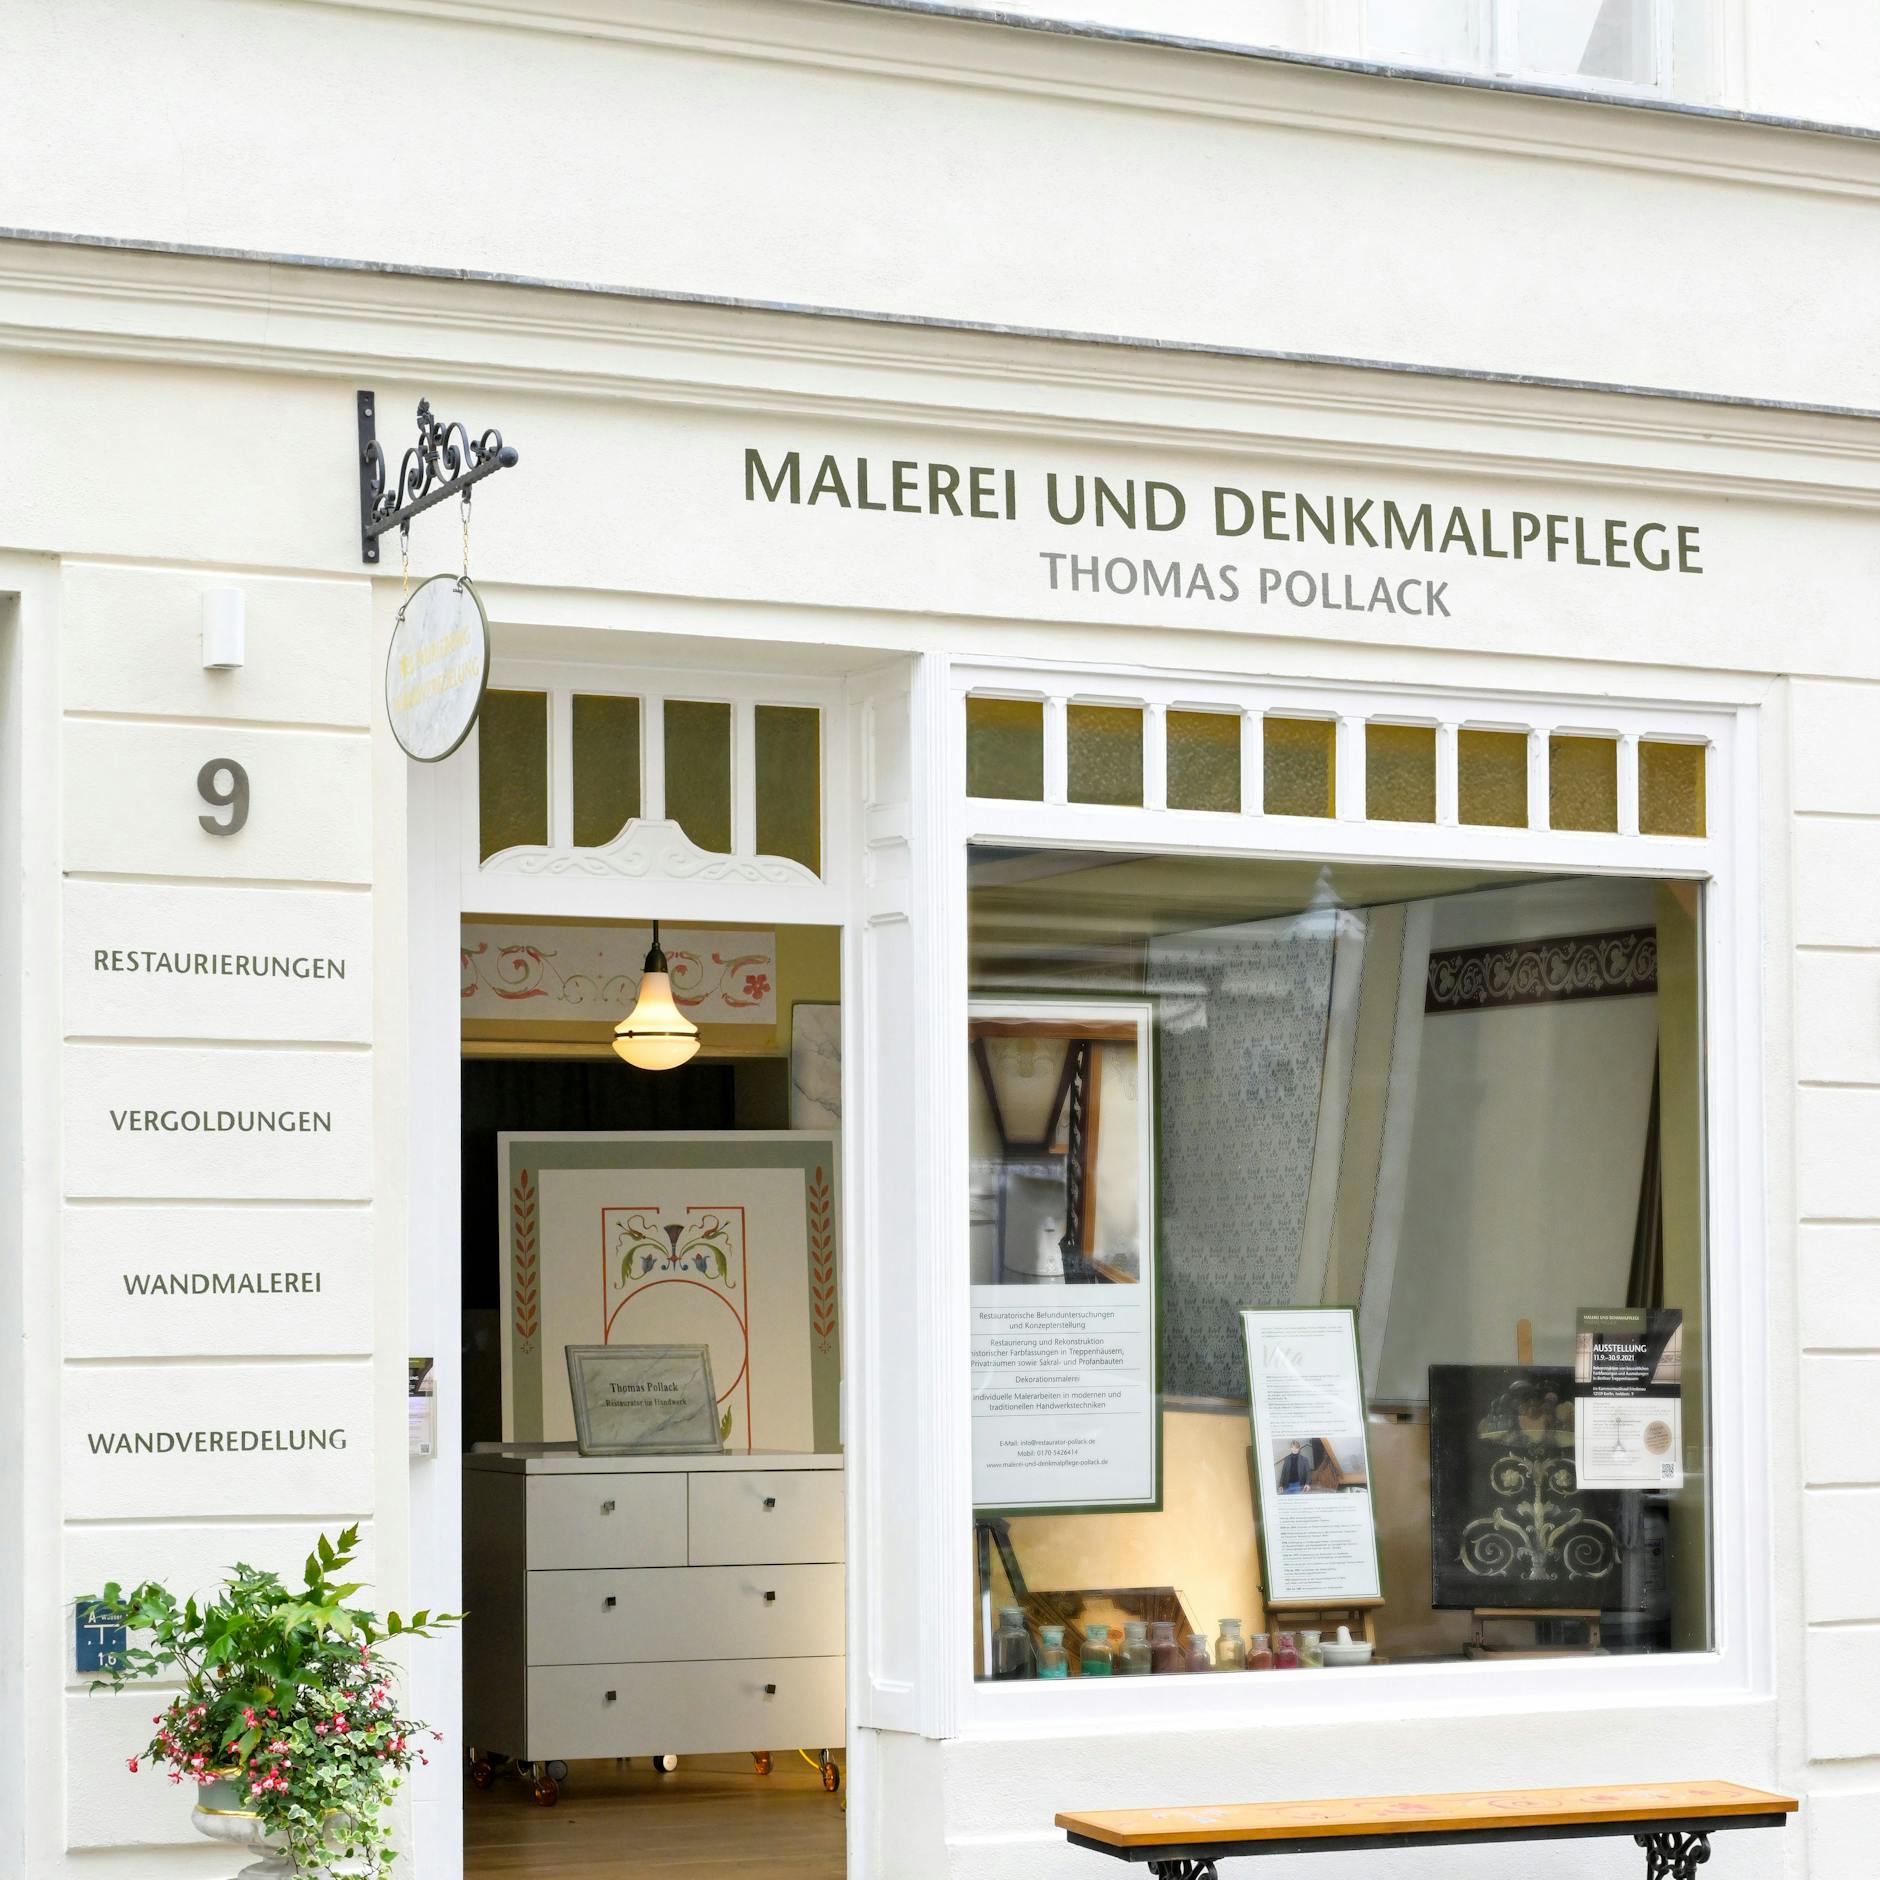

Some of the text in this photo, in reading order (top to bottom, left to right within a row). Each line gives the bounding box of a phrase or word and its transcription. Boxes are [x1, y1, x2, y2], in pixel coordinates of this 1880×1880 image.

[745, 449, 1703, 573] MALEREI UND DENKMALPFLEGE
[1040, 553, 1450, 616] THOMAS POLLACK
[198, 759, 249, 836] 9
[95, 951, 344, 978] RESTAURIERUNGEN
[110, 1111, 330, 1131] VERGOLDUNGEN
[124, 1273, 321, 1294] WANDMALEREI
[990, 1339, 1037, 1348] Restaurierung
[1055, 1337, 1104, 1345] Rekonstruktion
[1593, 1344, 1647, 1353] AUSSTELLUNG
[1010, 1349, 1059, 1357] Farbfassungen
[1039, 1358, 1061, 1366] Sakral-
[1079, 1357, 1124, 1365] Profanbauten
[609, 1382, 679, 1393] Thomas Pollack
[1108, 1390, 1122, 1398] und
[1036, 1402, 1106, 1410] Handwerkstechniken
[88, 1429, 345, 1453] WANDVEREDELUNG
